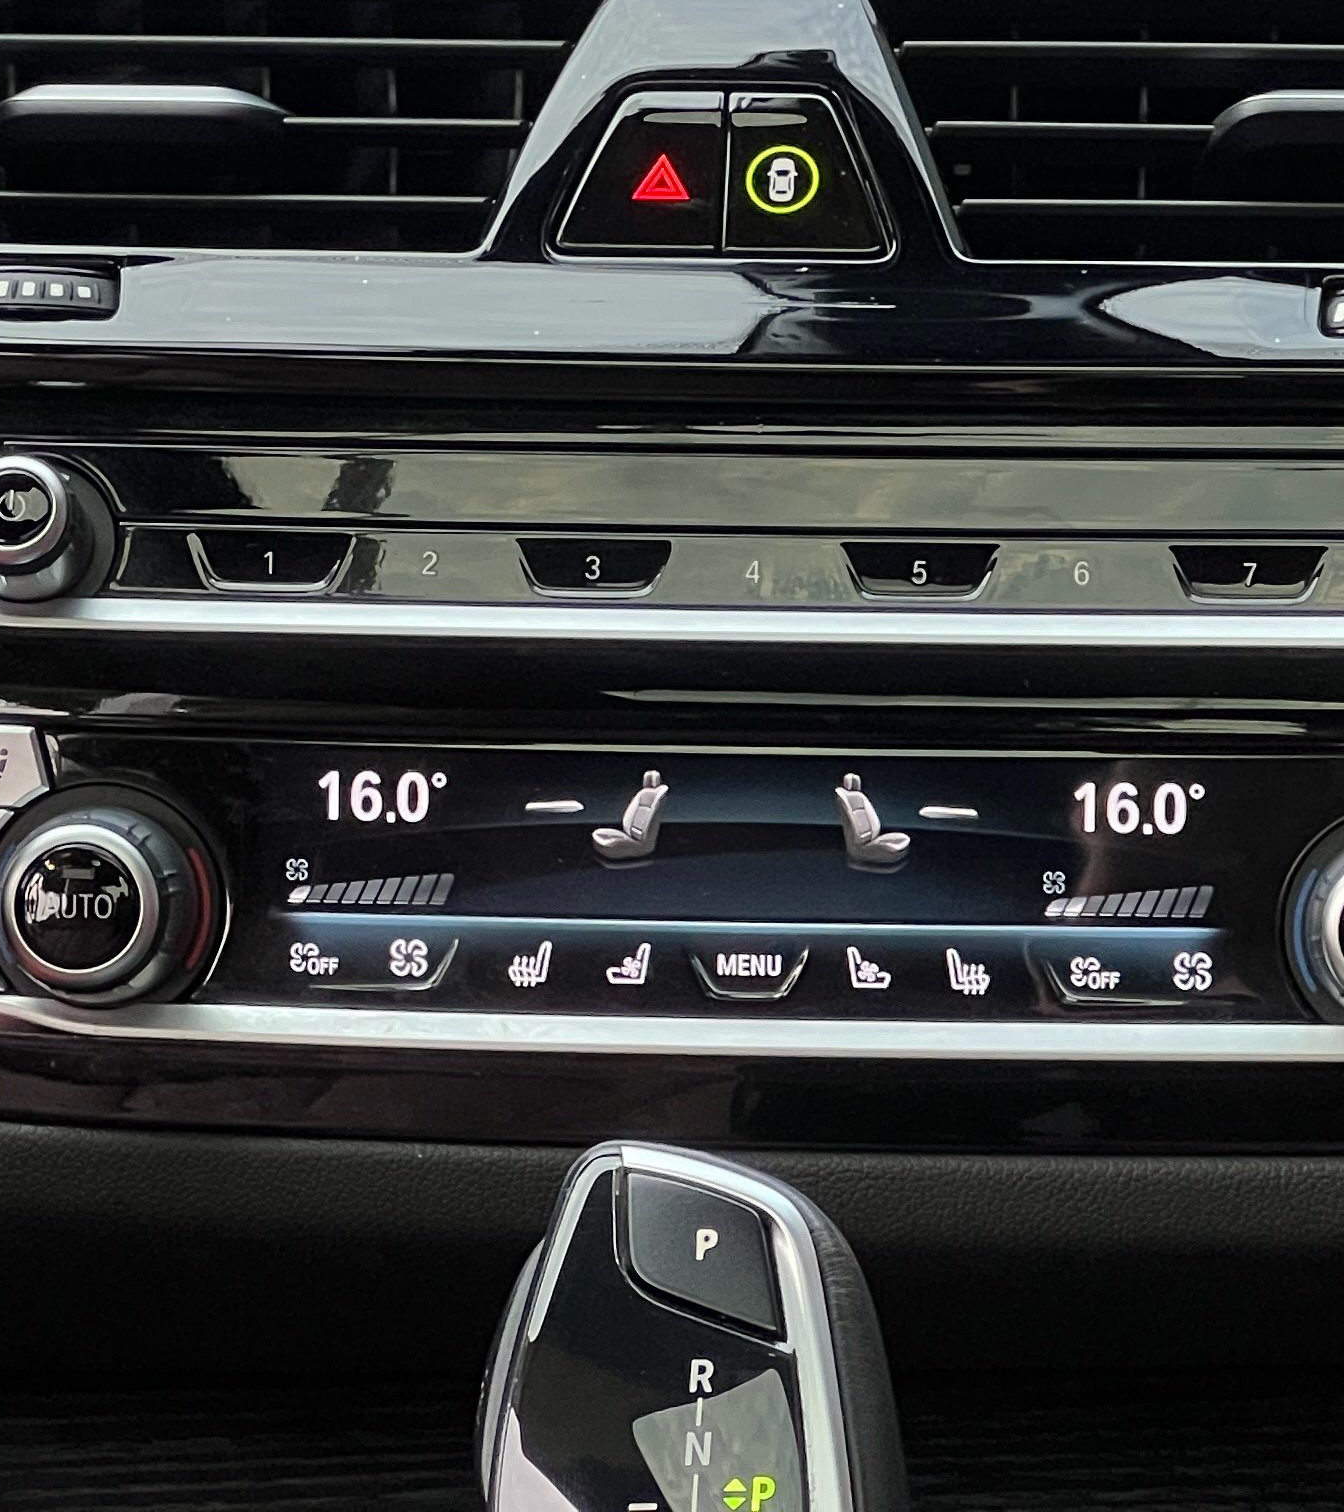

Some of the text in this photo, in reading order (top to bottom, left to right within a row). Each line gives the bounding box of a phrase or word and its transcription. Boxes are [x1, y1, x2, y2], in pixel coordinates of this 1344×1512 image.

[263, 551, 274, 575] 1
[422, 551, 438, 575] 2
[584, 555, 601, 580] 3
[745, 560, 760, 584] 4
[910, 560, 927, 585] 5
[1074, 561, 1090, 586] 6
[1241, 561, 1258, 587] 7
[318, 770, 448, 824] 16.0°
[1073, 781, 1206, 835] 16.0°
[42, 892, 114, 920] AUTO
[307, 956, 340, 977] OFF
[716, 953, 783, 977] MENU
[1088, 970, 1121, 990] OFF
[695, 1228, 719, 1261] P
[689, 1358, 715, 1394] R
[684, 1431, 713, 1467] N
[750, 1476, 777, 1512] P
